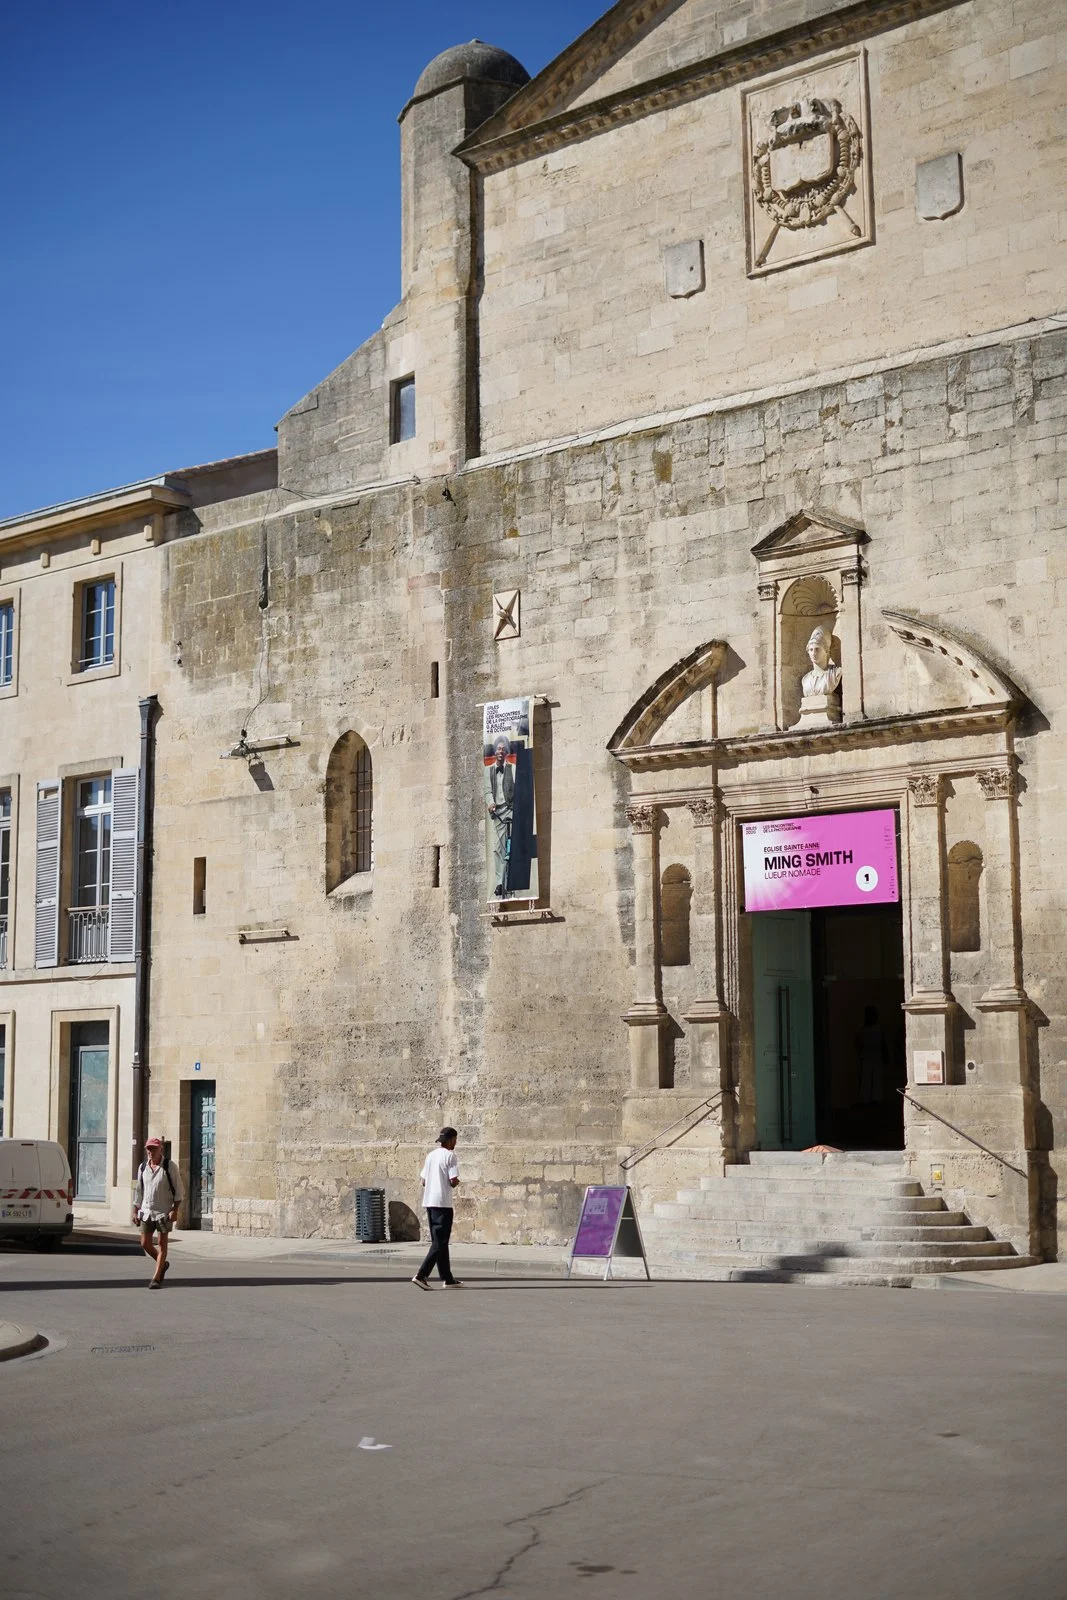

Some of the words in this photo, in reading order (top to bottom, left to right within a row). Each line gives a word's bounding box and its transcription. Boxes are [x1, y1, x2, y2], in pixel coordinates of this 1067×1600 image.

[495, 710, 521, 718] RENCONTRES
[764, 854, 802, 871] MING
[805, 849, 853, 867] SMITH
[764, 870, 787, 880] LUEUR
[788, 868, 821, 878] NOMADE
[864, 873, 870, 882] 1
